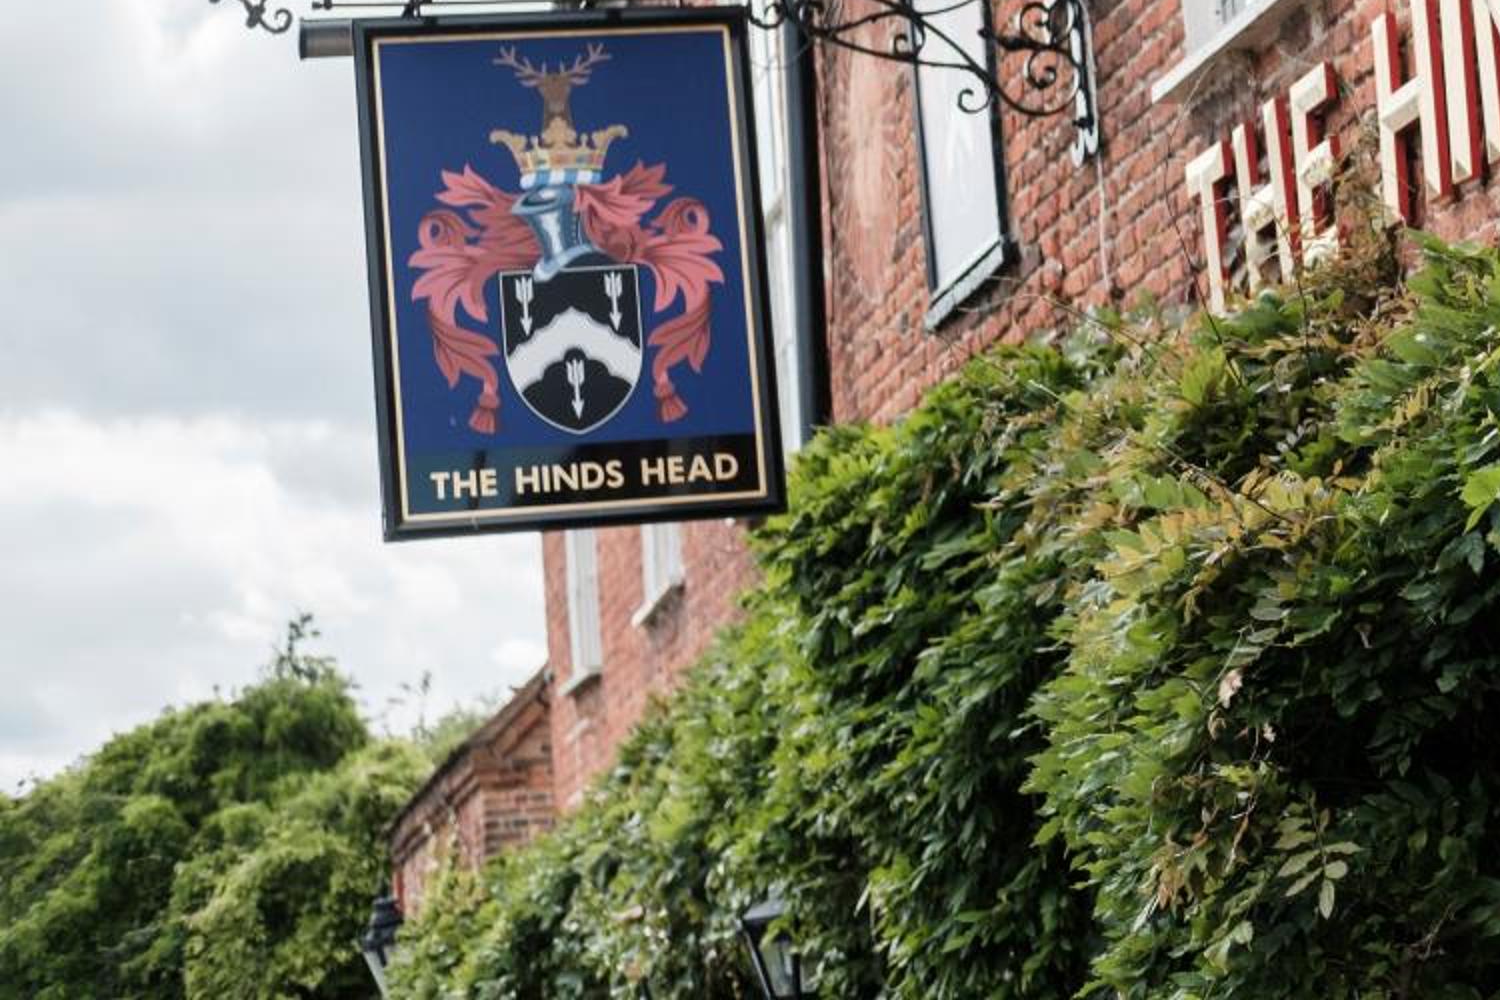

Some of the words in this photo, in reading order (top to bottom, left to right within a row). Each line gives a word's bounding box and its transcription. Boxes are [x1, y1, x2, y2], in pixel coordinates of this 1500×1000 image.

[1185, 60, 1341, 318] THE
[430, 468, 498, 500] THE
[515, 459, 624, 496] HINDS
[640, 453, 739, 486] HEAD
